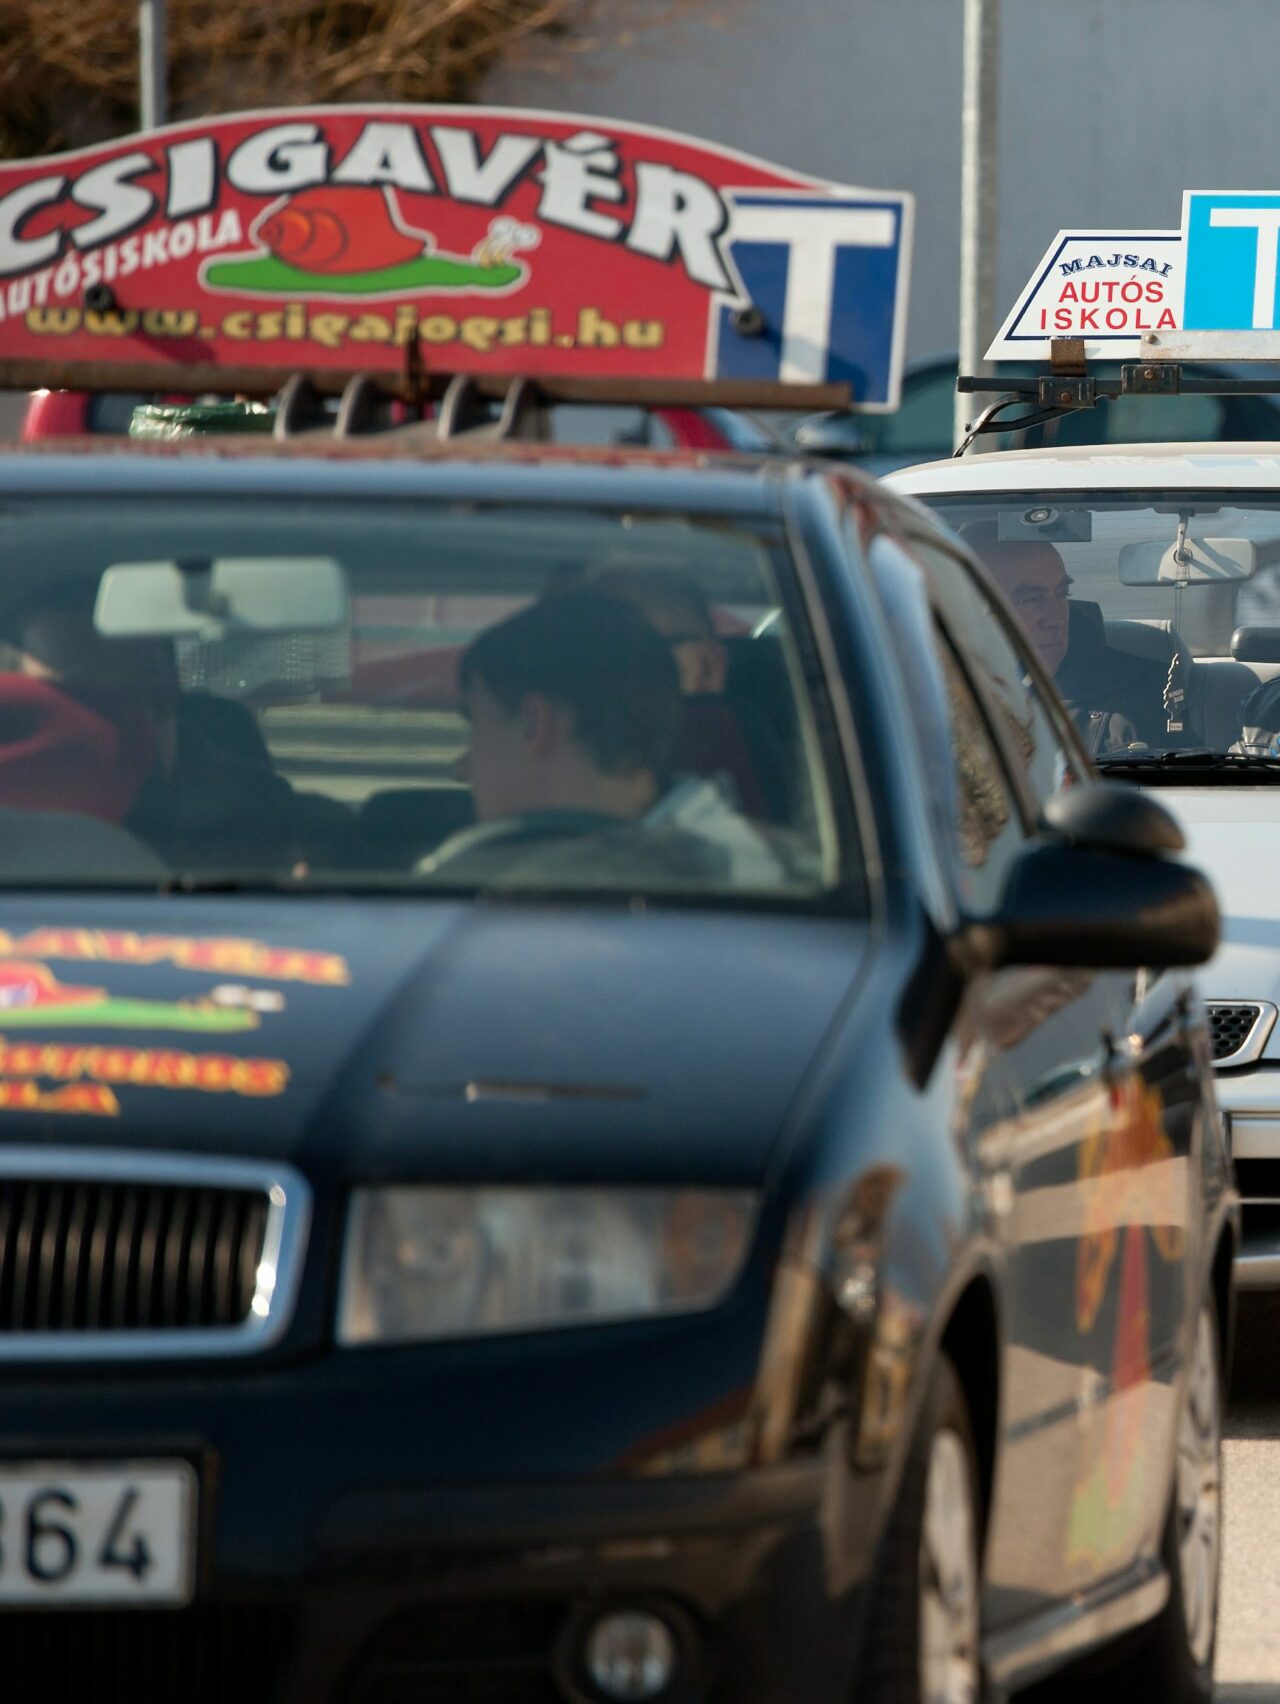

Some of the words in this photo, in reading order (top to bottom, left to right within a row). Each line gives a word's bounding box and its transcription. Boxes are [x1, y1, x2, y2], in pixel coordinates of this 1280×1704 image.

[0, 120, 738, 296] CSIGAVÉR
[1058, 253, 1174, 278] MAJSAI
[1058, 274, 1165, 304] AUTÓS
[729, 208, 896, 384] T
[1040, 307, 1178, 331] ISKOLA
[23, 302, 666, 352] www.csigajogsi.hu
[0, 1485, 154, 1584] 64
